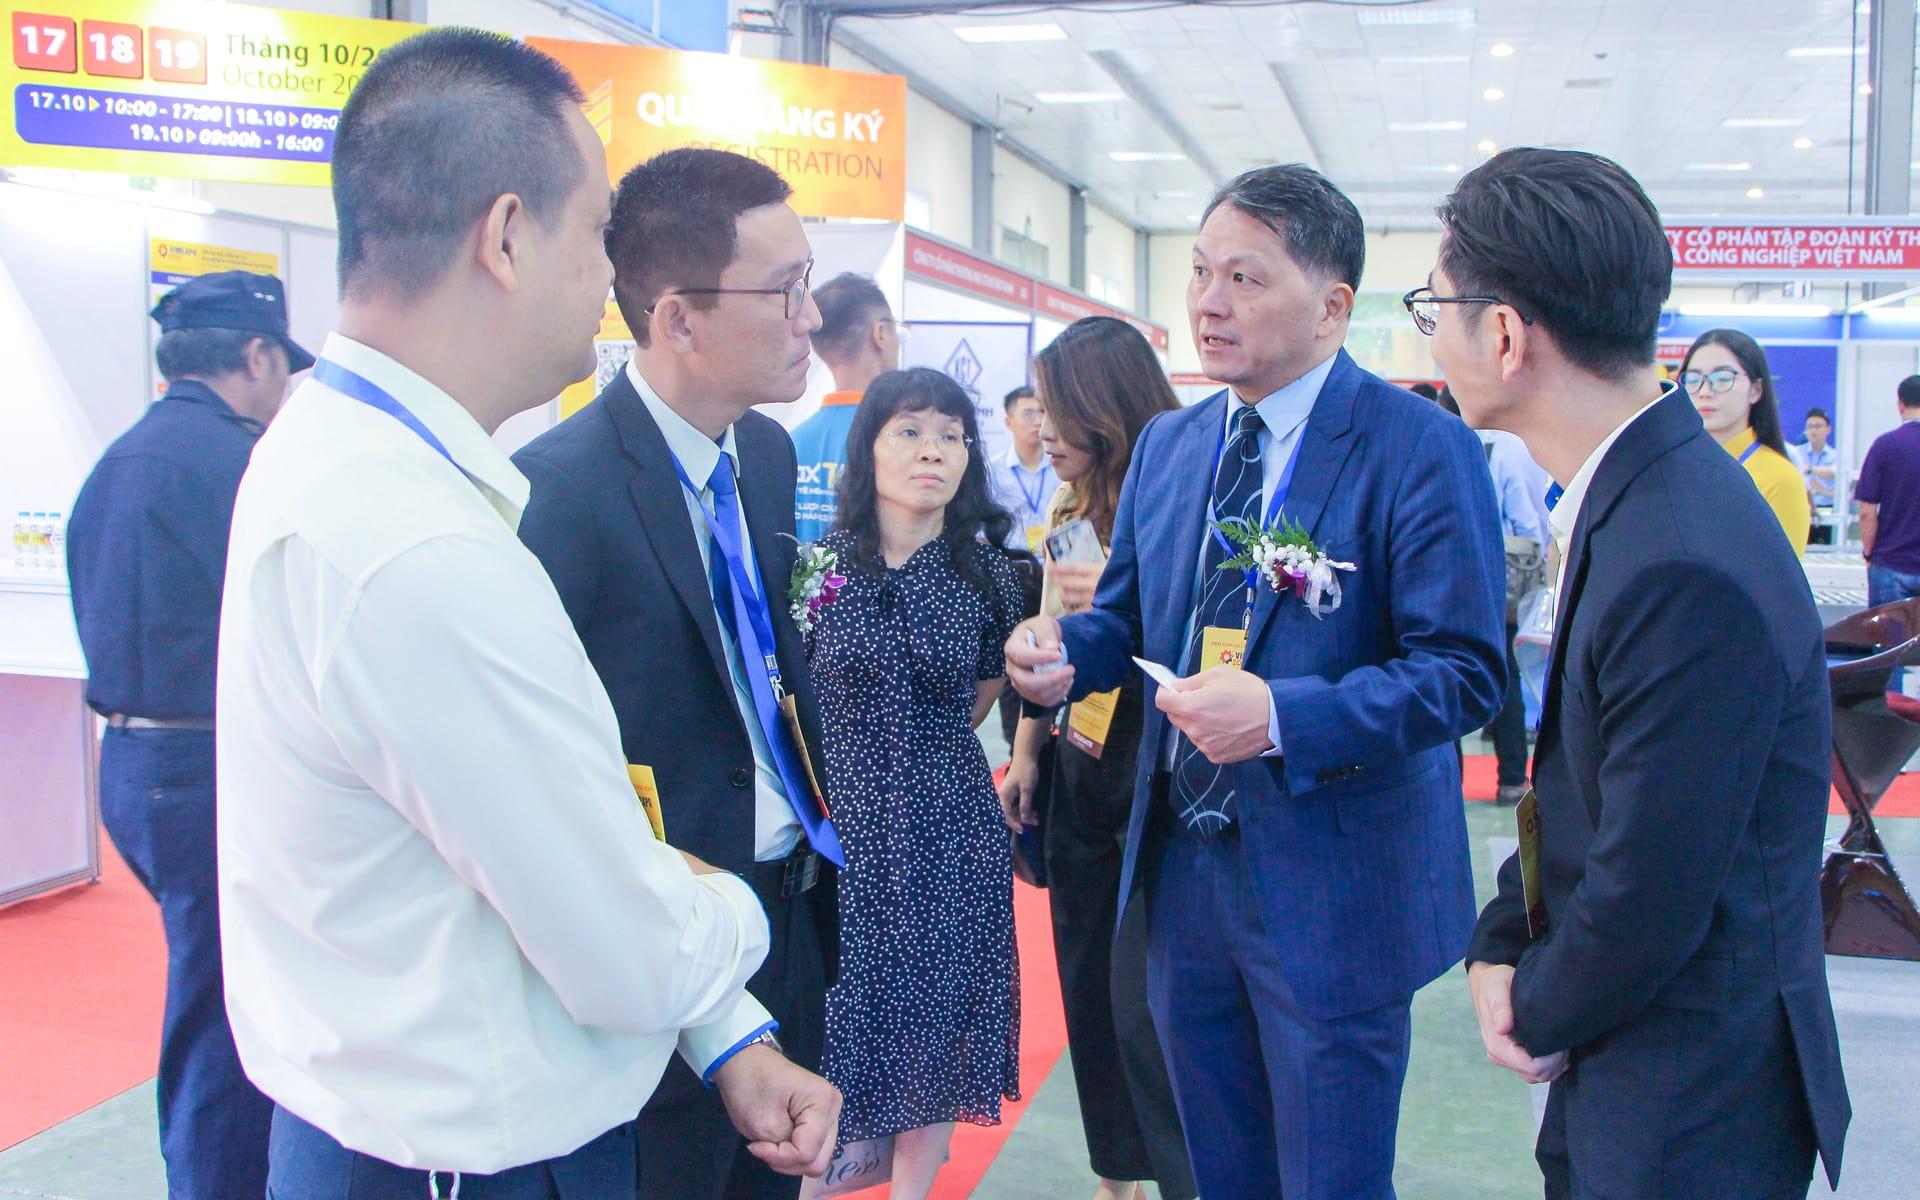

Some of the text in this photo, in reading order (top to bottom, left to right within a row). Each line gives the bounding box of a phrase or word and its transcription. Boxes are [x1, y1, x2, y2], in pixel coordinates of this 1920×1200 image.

[20, 25, 200, 70] 17 18 19
[225, 33, 376, 67] Tháng 10/2
[223, 63, 361, 95] October 20
[29, 91, 86, 111] 17.10
[105, 97, 158, 118] 10:00
[172, 102, 223, 123] 17:00
[236, 107, 287, 128] 18.10
[301, 113, 339, 131] 09:0
[843, 108, 885, 143] KÝ
[130, 123, 184, 143] 19.10
[199, 129, 261, 148] 09:00h
[276, 133, 324, 152] 16:00
[691, 140, 883, 180] ISTRATION
[1686, 225, 1712, 246] CỔ
[1770, 227, 1806, 248] TẬP
[1809, 227, 1865, 246] ĐOÀN
[1869, 226, 1893, 246] KỸ
[1685, 246, 1739, 264] CÔNG
[1742, 245, 1811, 268] NGHIỆP
[1814, 245, 1856, 268] VIỆT
[1859, 248, 1904, 264] NAM
